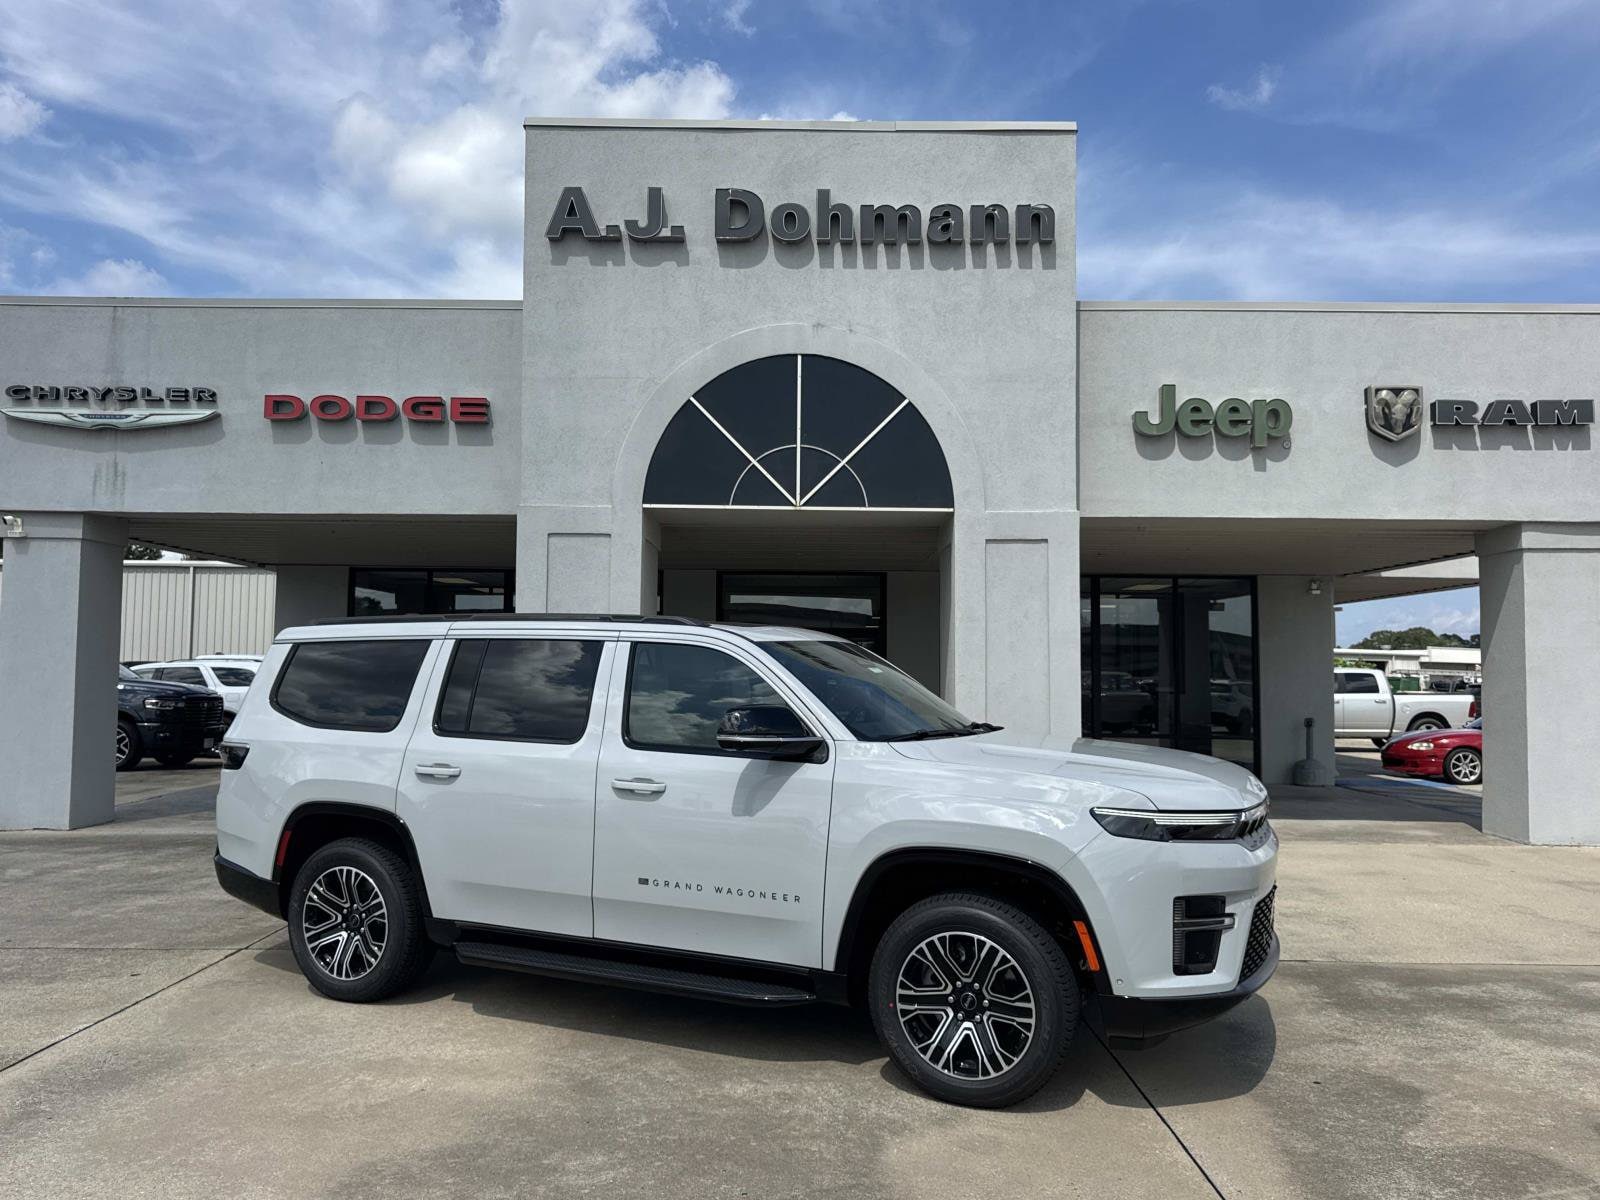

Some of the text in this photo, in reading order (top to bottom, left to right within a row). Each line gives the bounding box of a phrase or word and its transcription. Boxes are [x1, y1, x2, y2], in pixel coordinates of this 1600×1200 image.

[544, 186, 1056, 244] A.J. Dohmann
[4, 384, 217, 401] CHRYSLER
[263, 394, 491, 423] DODGE
[1132, 384, 1293, 448] Jeep
[1430, 399, 1595, 426] RAM
[652, 878, 802, 903] GRAND WAGONEER
